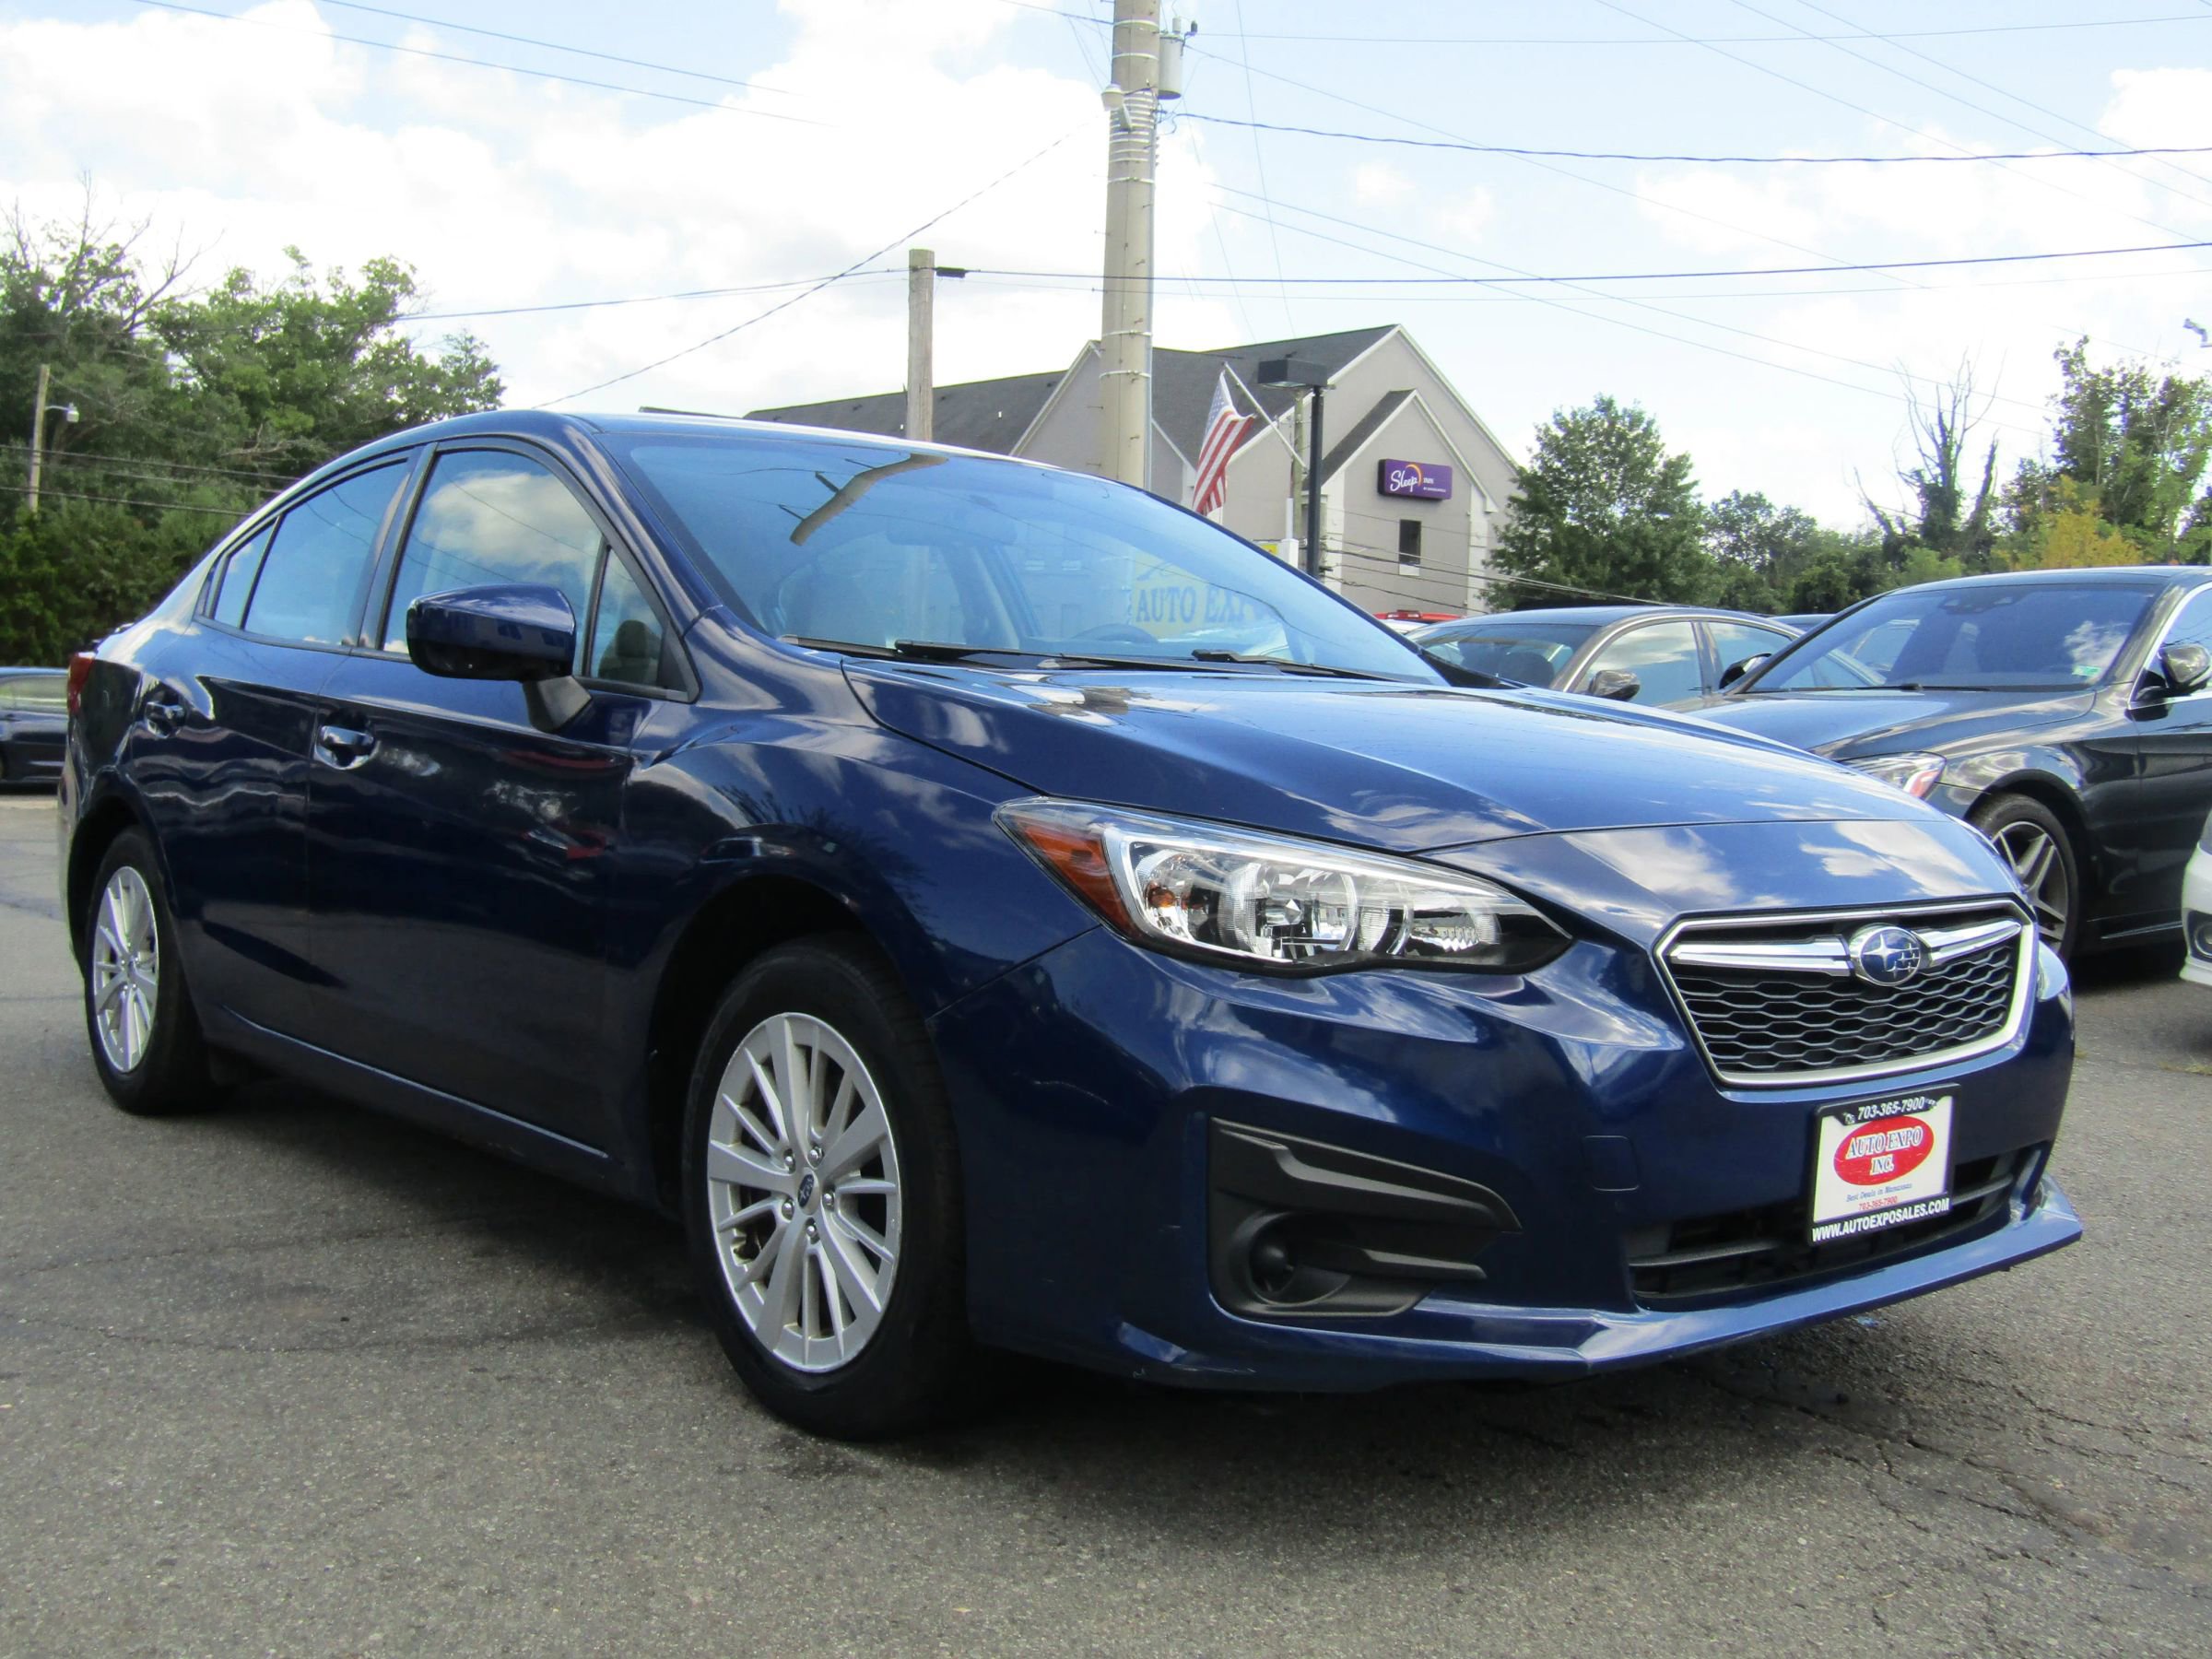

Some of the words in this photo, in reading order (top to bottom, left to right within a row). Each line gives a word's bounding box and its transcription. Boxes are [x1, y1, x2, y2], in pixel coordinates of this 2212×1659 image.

[1390, 470, 1418, 492] Sleep
[1135, 586, 1196, 623] AUTO
[1857, 1096, 1925, 1121] 703-365-7900
[1846, 1133, 1886, 1159] AUTO
[1886, 1126, 1924, 1151] EXPO
[1870, 1154, 1895, 1175] INC.
[1812, 1198, 1949, 1242] WWW.AUTOEXPOSALES.COM
